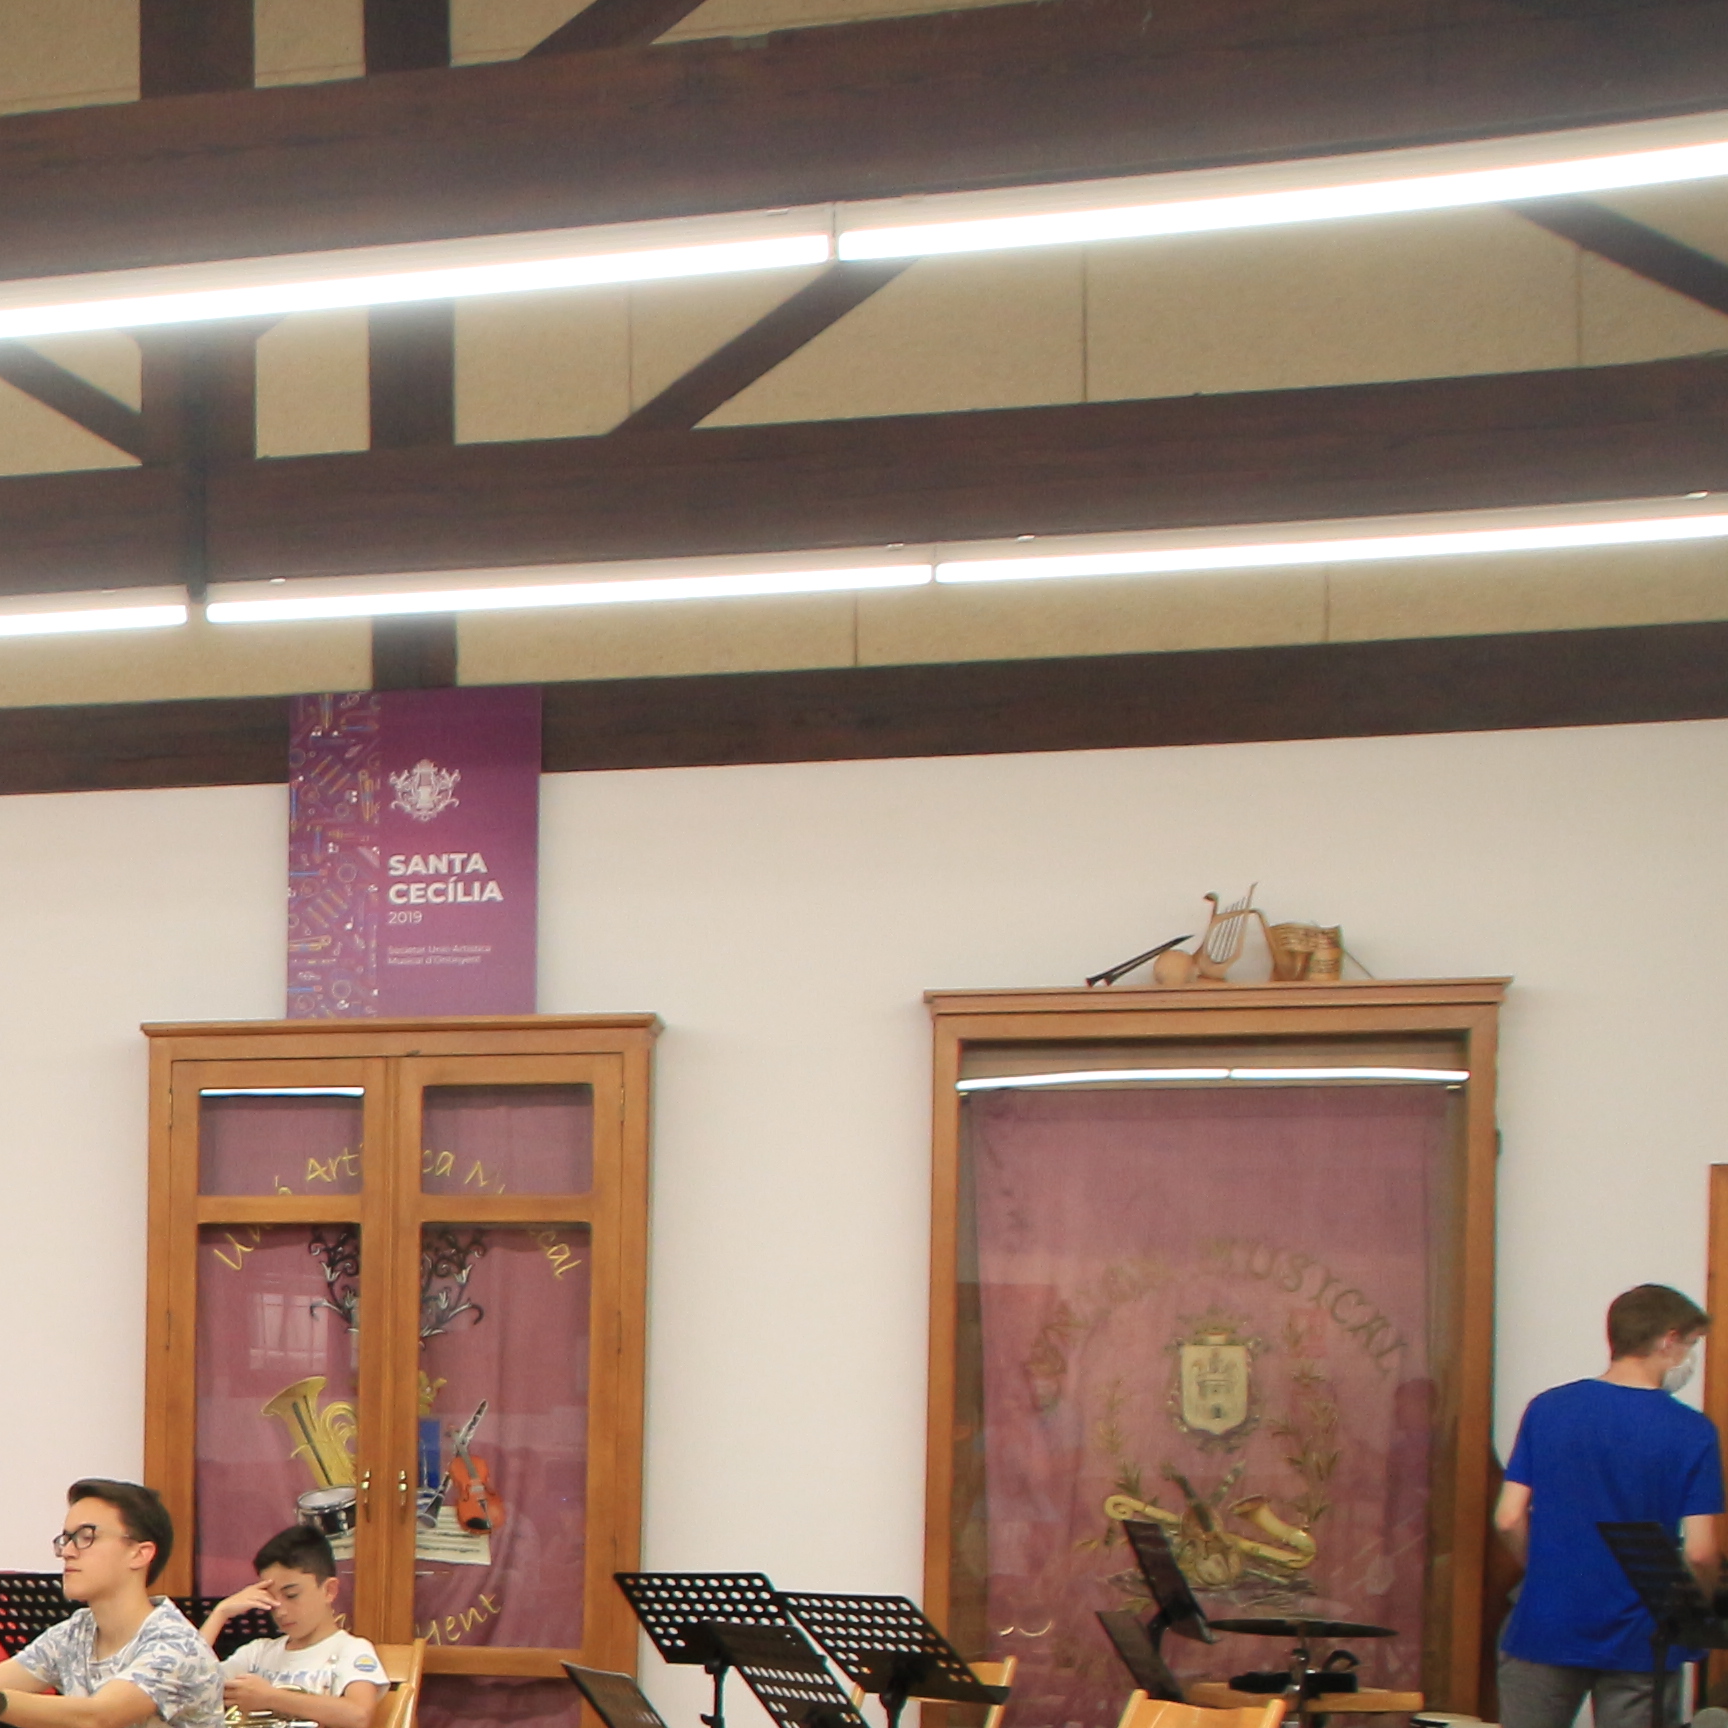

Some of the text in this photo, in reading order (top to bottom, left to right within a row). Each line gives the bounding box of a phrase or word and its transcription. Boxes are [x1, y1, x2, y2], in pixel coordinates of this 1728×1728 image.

[388, 852, 488, 876] SANTA
[388, 876, 504, 905] CECÍLIA
[388, 911, 423, 924] 2019
